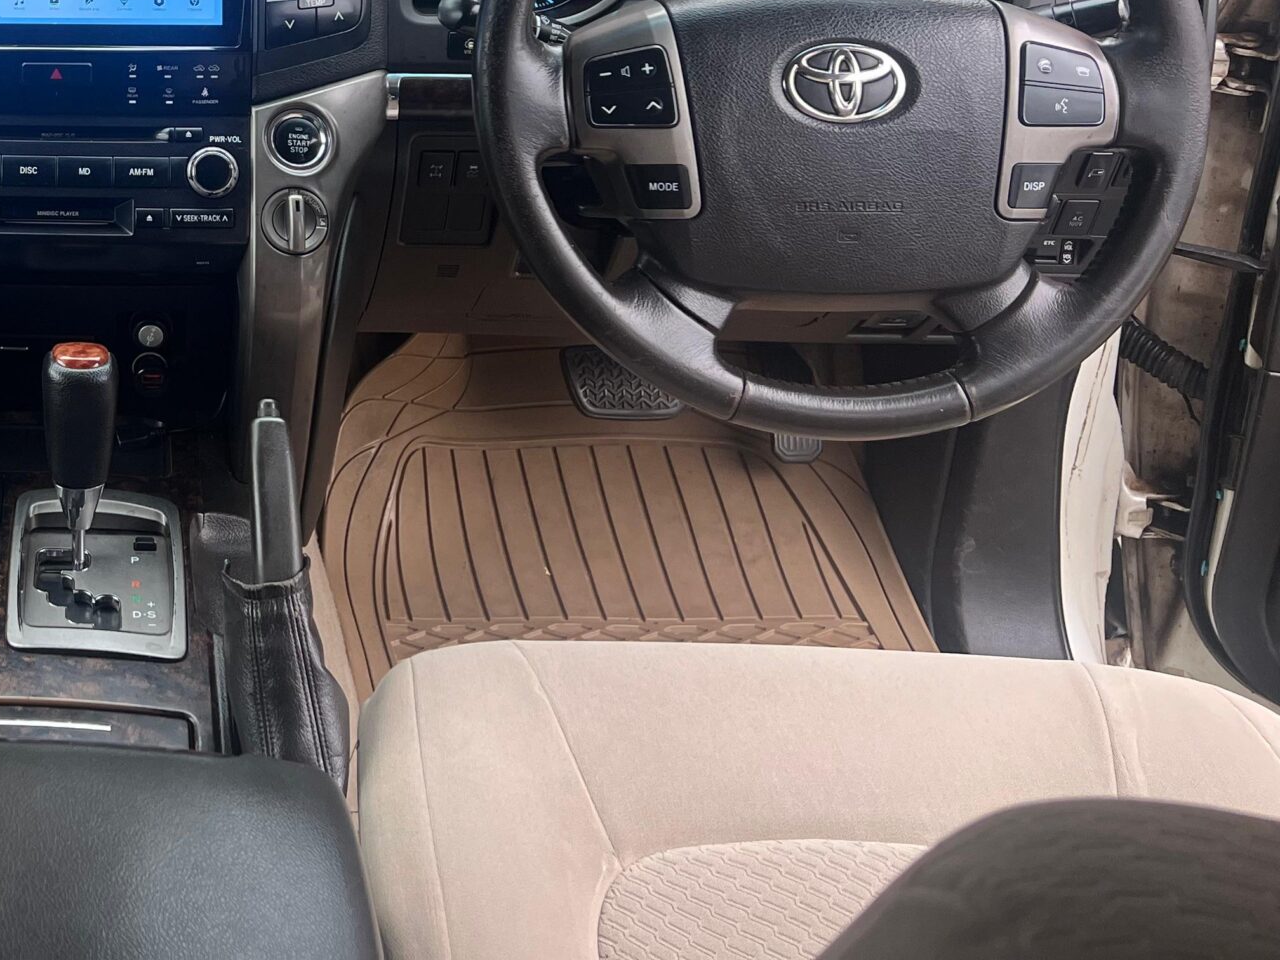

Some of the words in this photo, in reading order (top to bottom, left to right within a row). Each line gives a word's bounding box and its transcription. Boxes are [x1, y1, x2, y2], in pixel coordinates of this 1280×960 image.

[290, 146, 309, 154] STOP
[19, 166, 38, 175] DISC
[649, 182, 679, 191] MODE
[1023, 181, 1046, 191] DISP
[838, 200, 905, 213] AIRBAG
[130, 556, 140, 564] P
[131, 580, 141, 589] R
